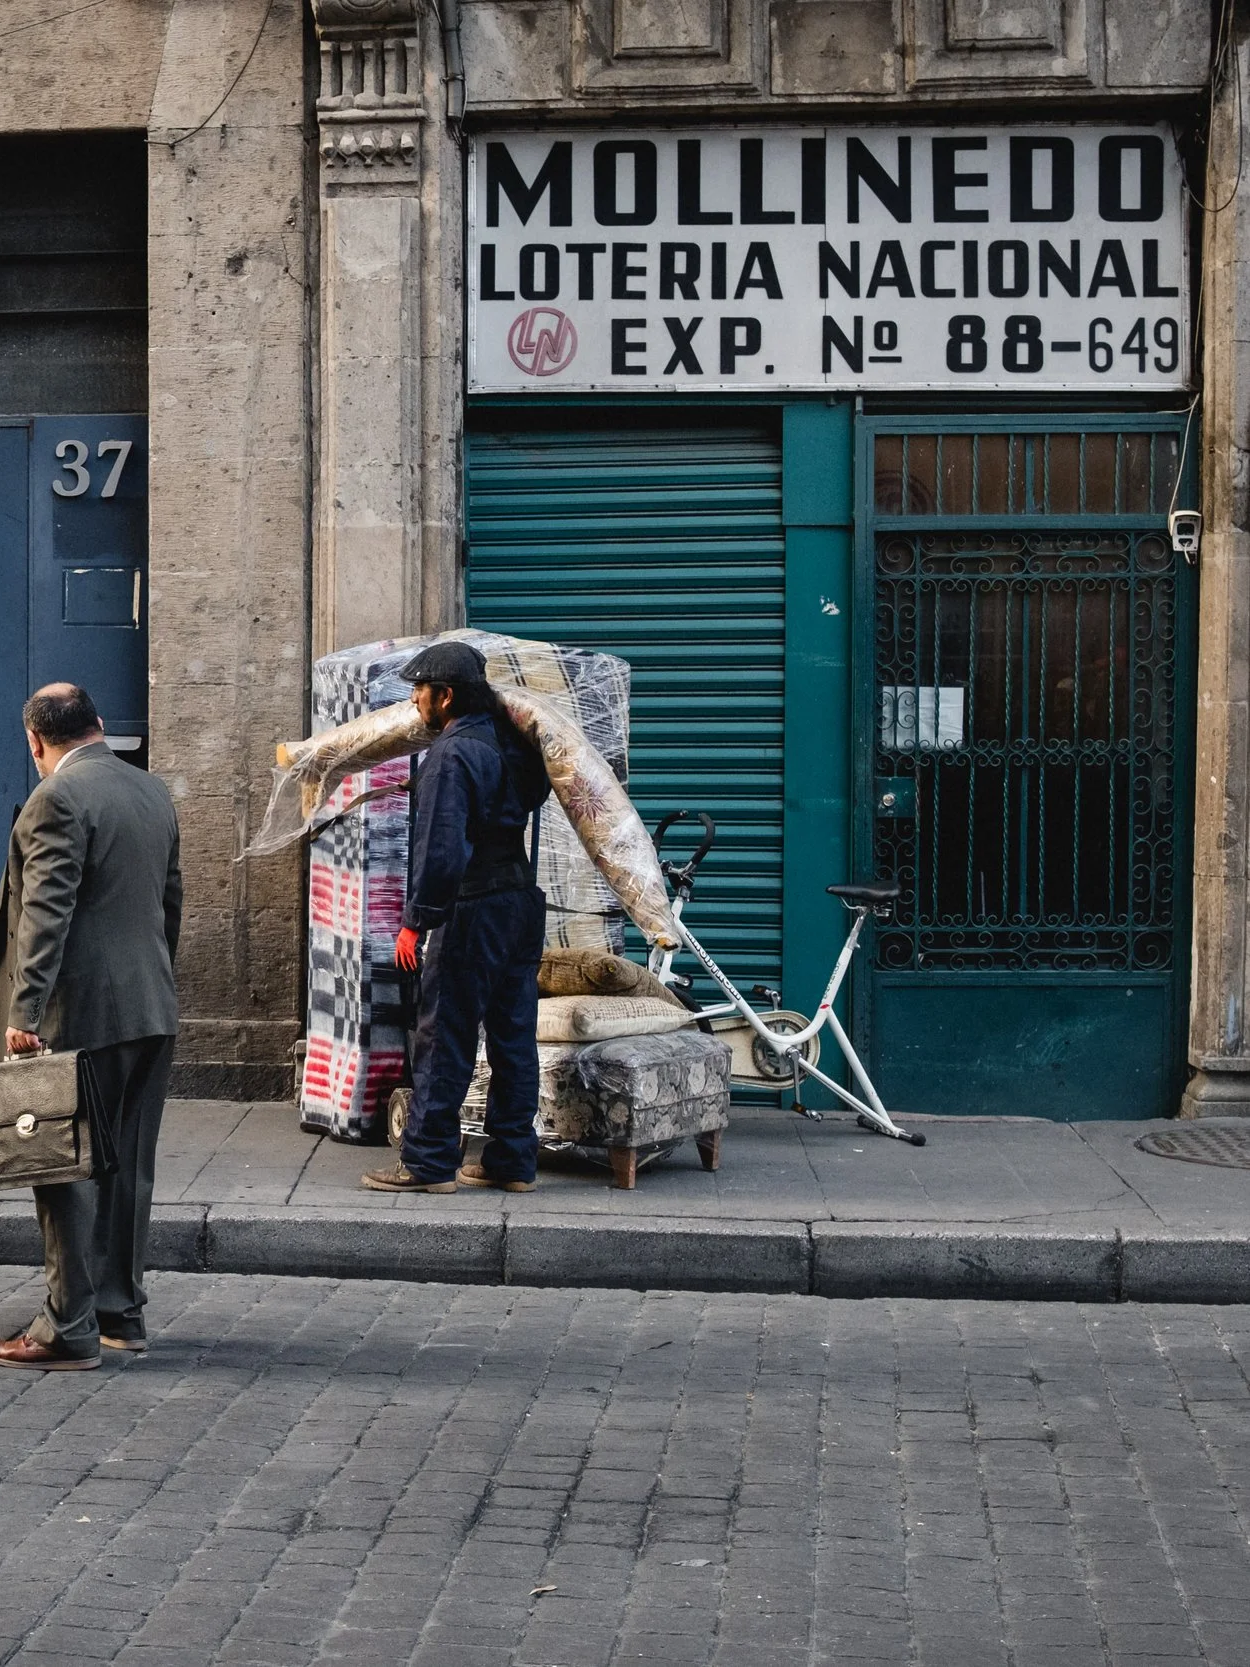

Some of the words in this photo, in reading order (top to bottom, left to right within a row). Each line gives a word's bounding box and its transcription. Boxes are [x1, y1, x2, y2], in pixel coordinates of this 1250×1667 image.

[486, 135, 1165, 227] MOLLINEDO
[480, 242, 783, 300] LOTERIA
[819, 239, 1178, 299] NACIONAL
[612, 317, 774, 375] EXP.
[947, 315, 1178, 373] 88-649
[52, 440, 133, 498] 37
